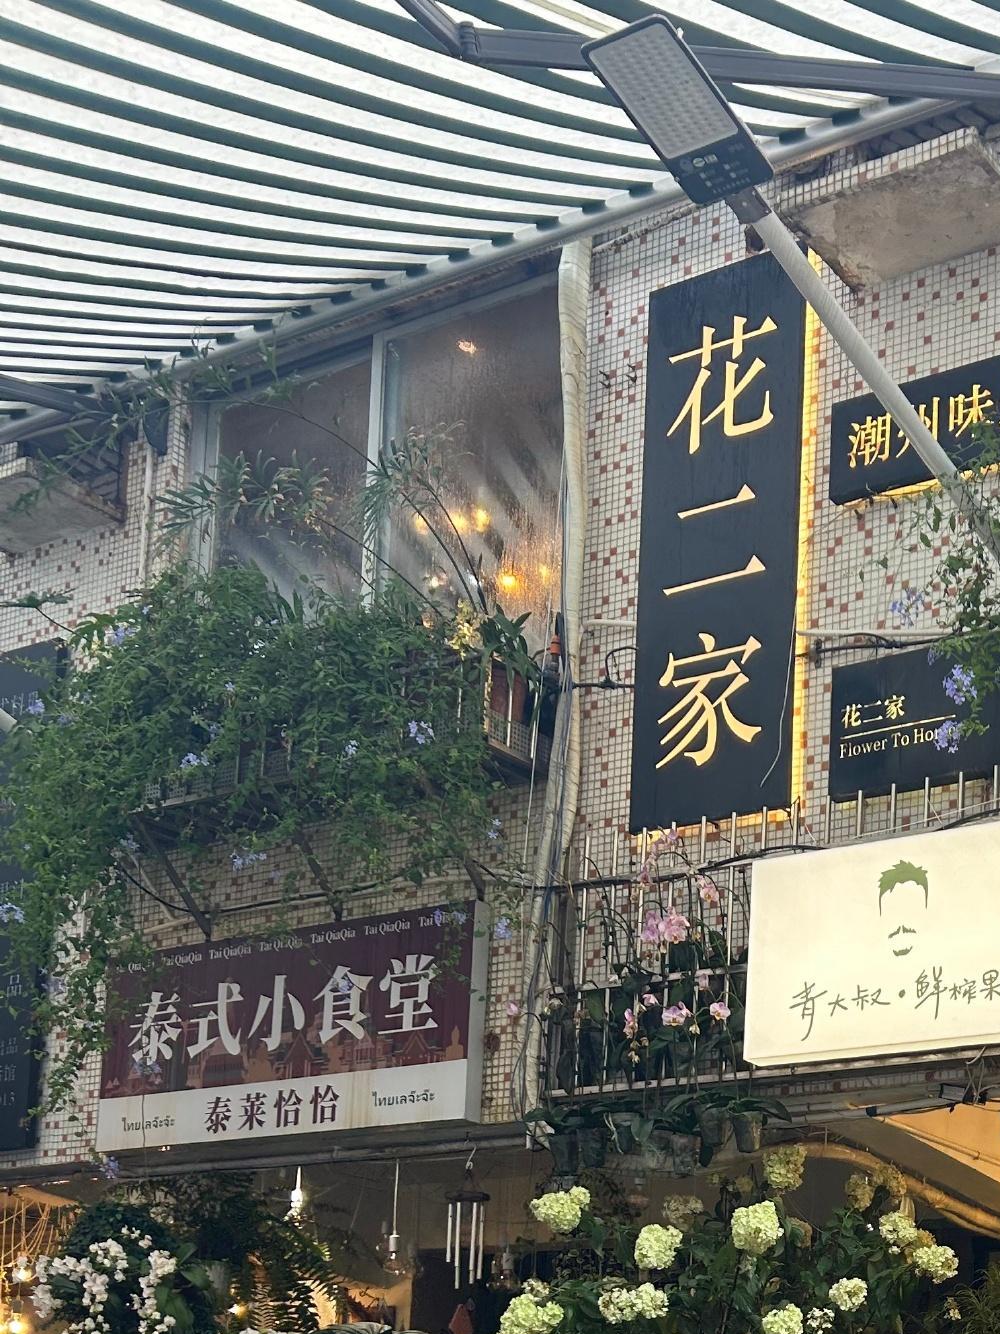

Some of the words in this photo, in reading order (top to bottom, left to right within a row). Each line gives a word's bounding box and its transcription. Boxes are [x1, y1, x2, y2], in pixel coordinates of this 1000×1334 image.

[654, 313, 780, 770] 花二家
[840, 694, 906, 729] 花二家
[839, 737, 888, 759] Flower
[891, 732, 910, 748] To
[128, 953, 439, 1065] 泰式小食堂
[204, 1084, 341, 1135] 泰莱恰恰
